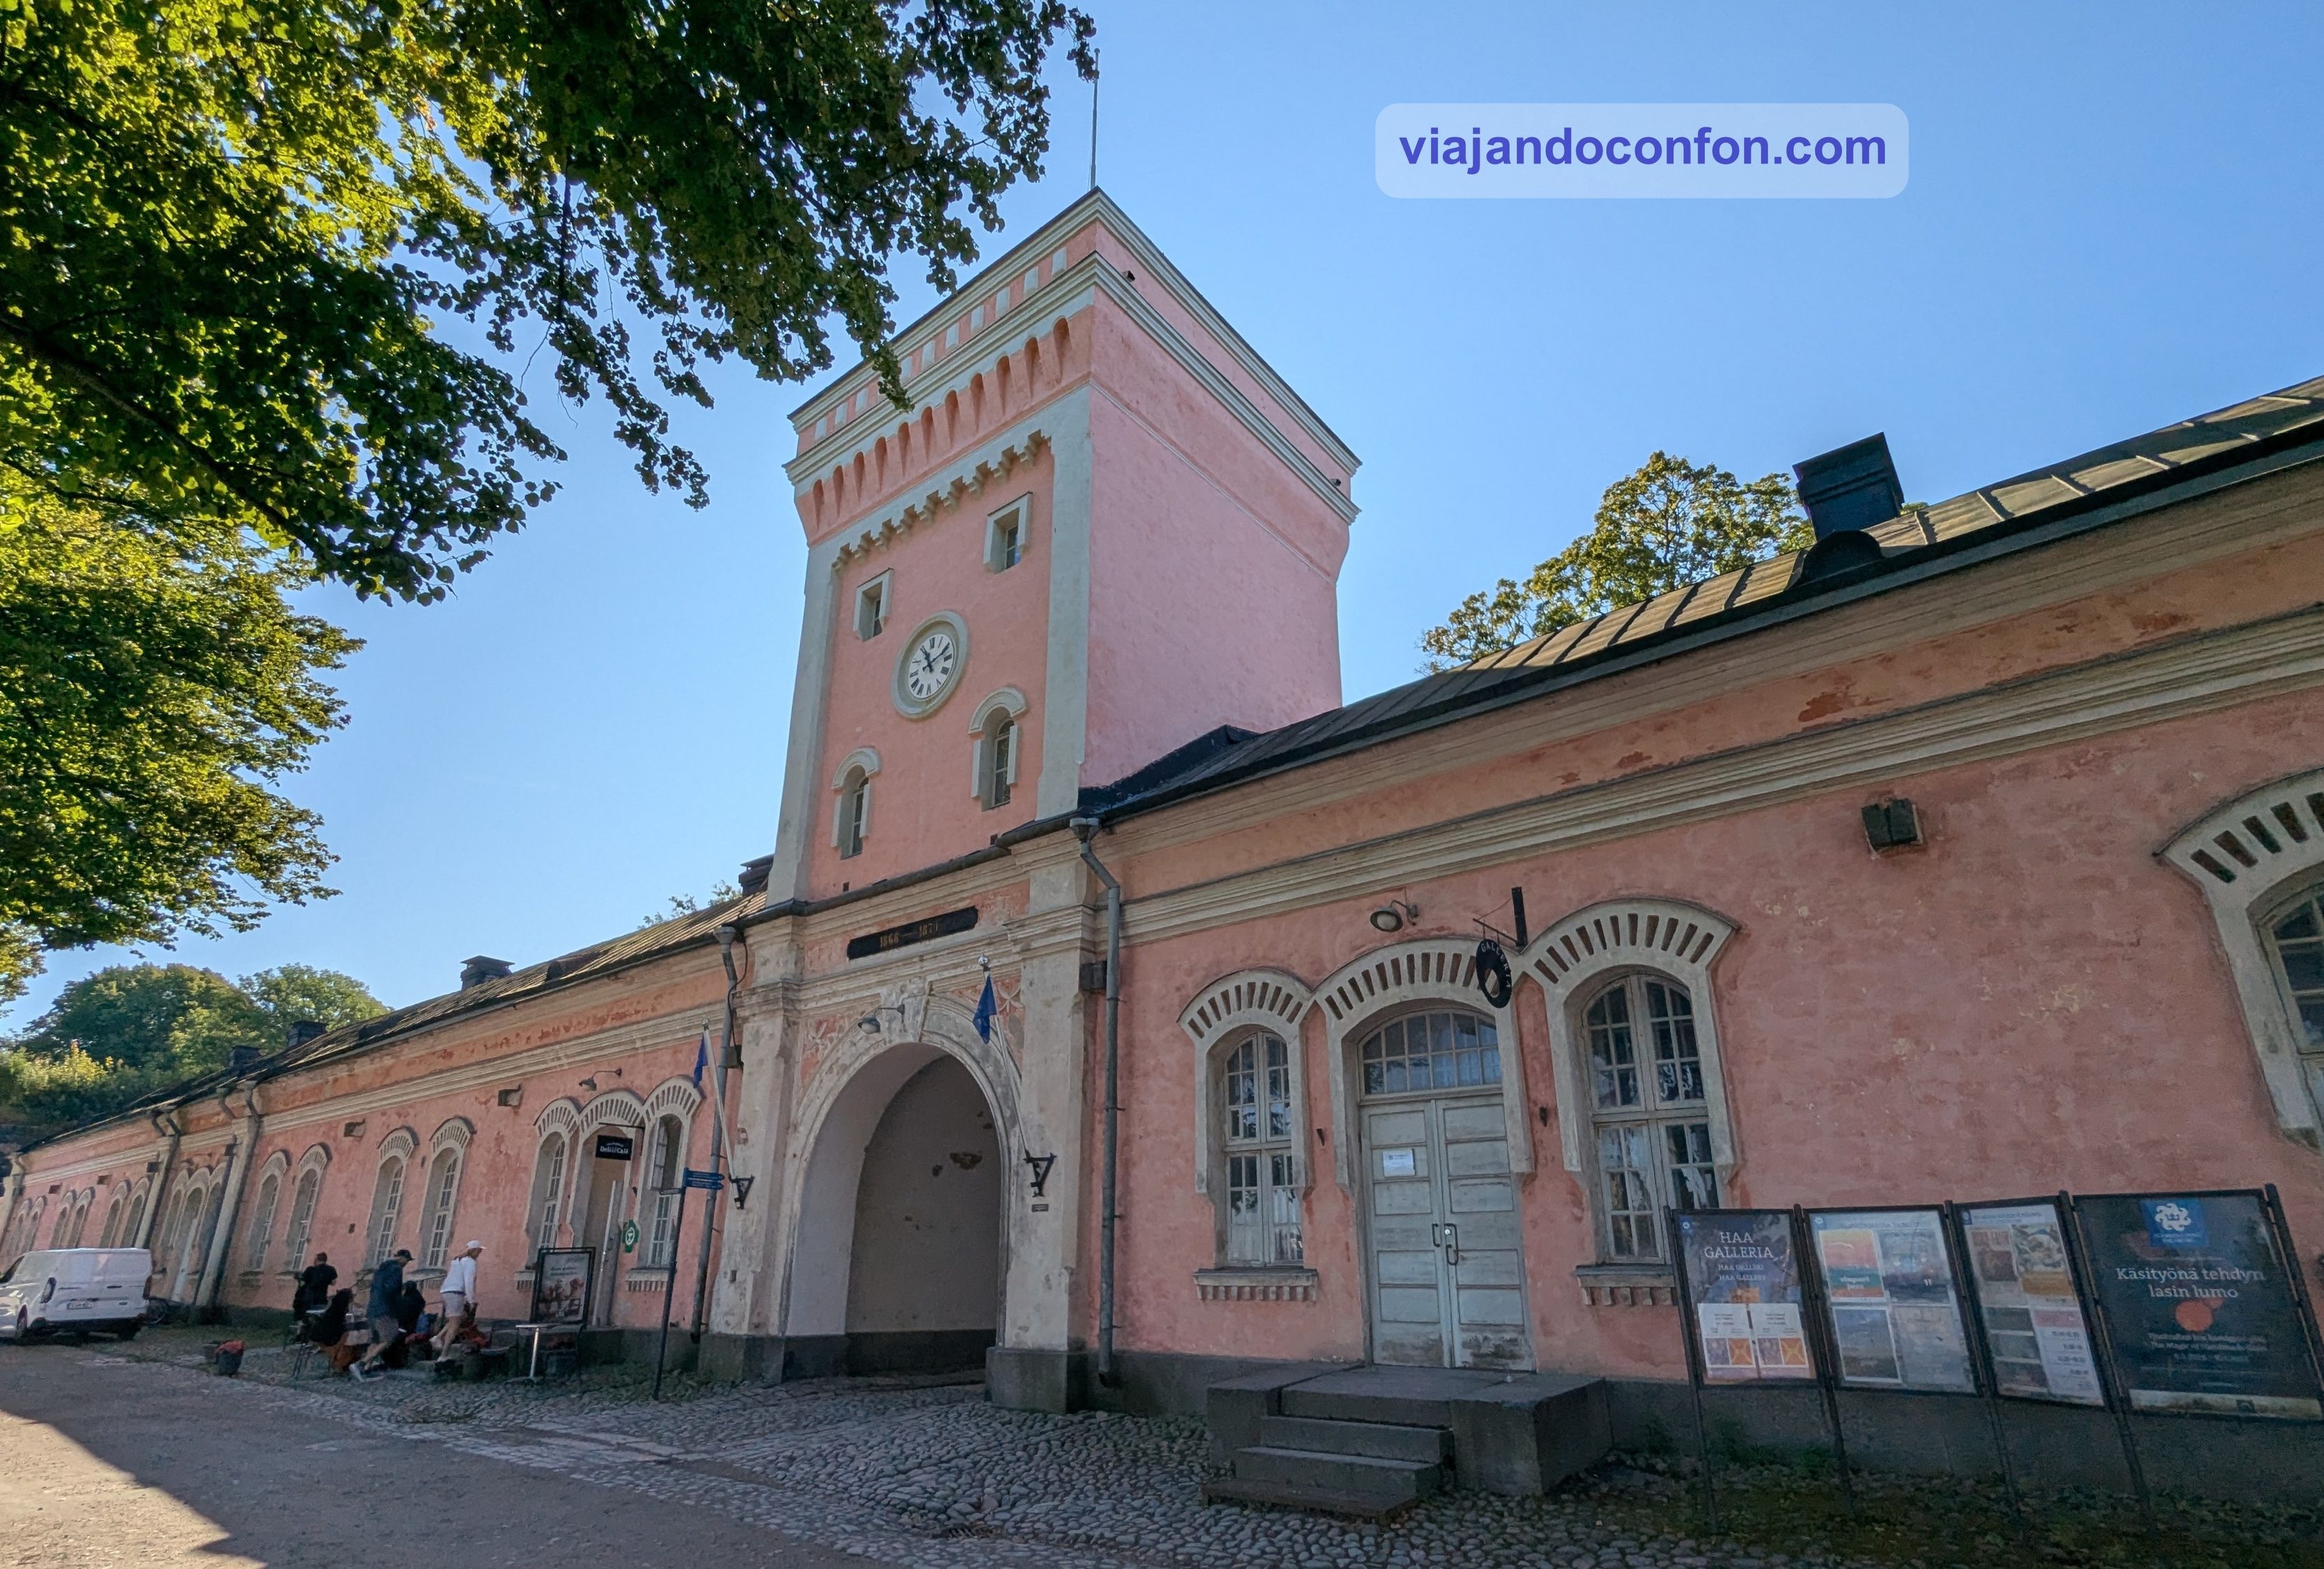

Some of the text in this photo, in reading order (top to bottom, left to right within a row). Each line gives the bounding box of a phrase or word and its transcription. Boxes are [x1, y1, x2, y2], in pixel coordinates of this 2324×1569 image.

[1480, 942, 1511, 987] GALLERIA
[1719, 1231, 1754, 1243] HAA
[1704, 1246, 1774, 1259] GALLERIA
[2118, 1267, 2265, 1284] Käsityönä tehdyn
[2150, 1284, 2239, 1298] lasin lumo
